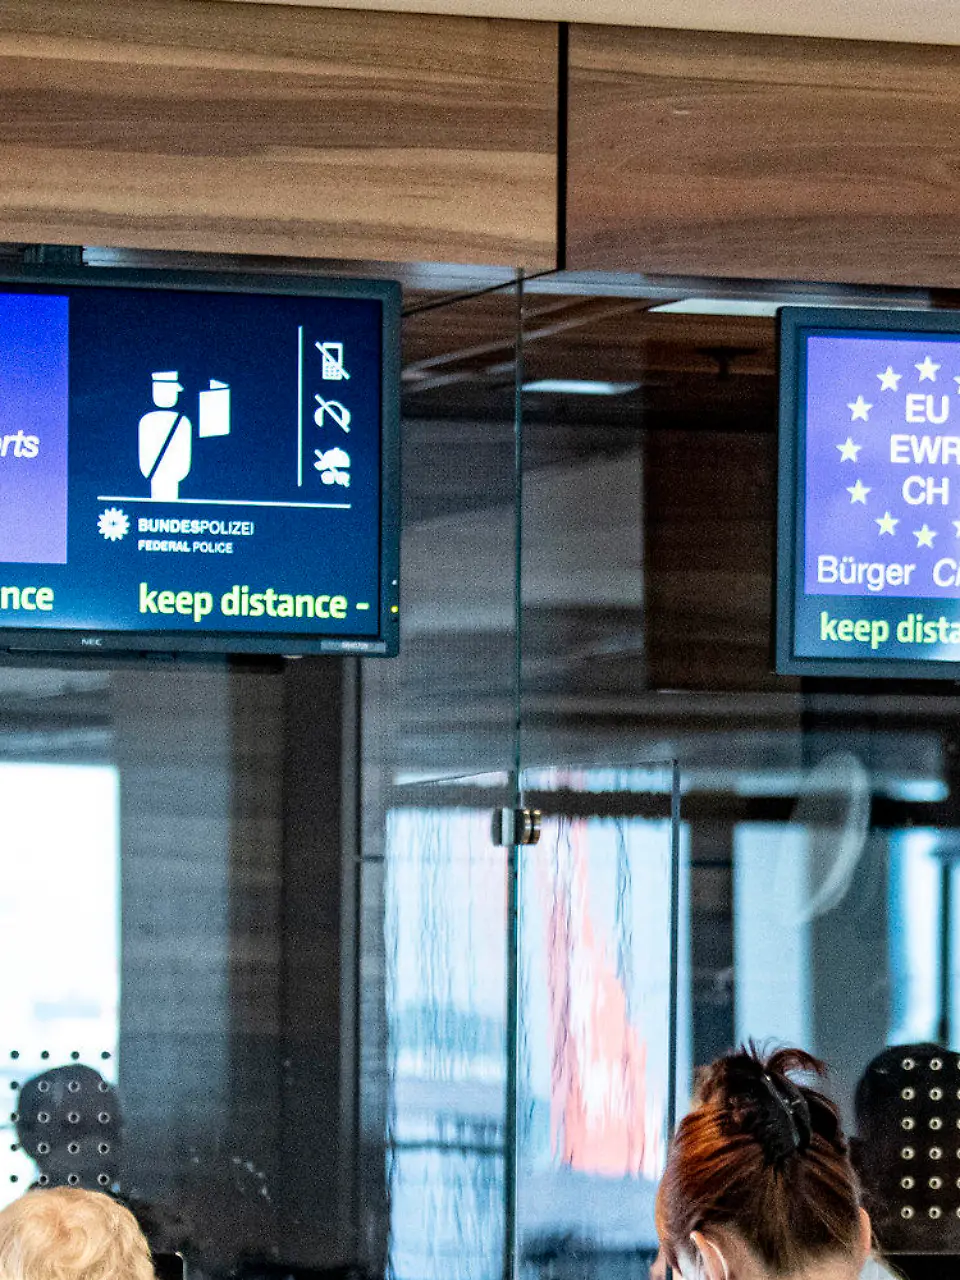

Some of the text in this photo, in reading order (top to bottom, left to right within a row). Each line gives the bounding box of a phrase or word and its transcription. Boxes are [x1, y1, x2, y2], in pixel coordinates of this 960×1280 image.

[905, 393, 950, 424] EU
[0, 429, 41, 458] rts
[901, 475, 950, 506] CH
[137, 518, 255, 536] BUNDESPOLIZEI
[137, 540, 234, 554] FEDERAL POLICE
[817, 555, 916, 592] Bürger
[138, 582, 213, 622] keep
[220, 584, 348, 619] distance
[819, 611, 889, 649] keep
